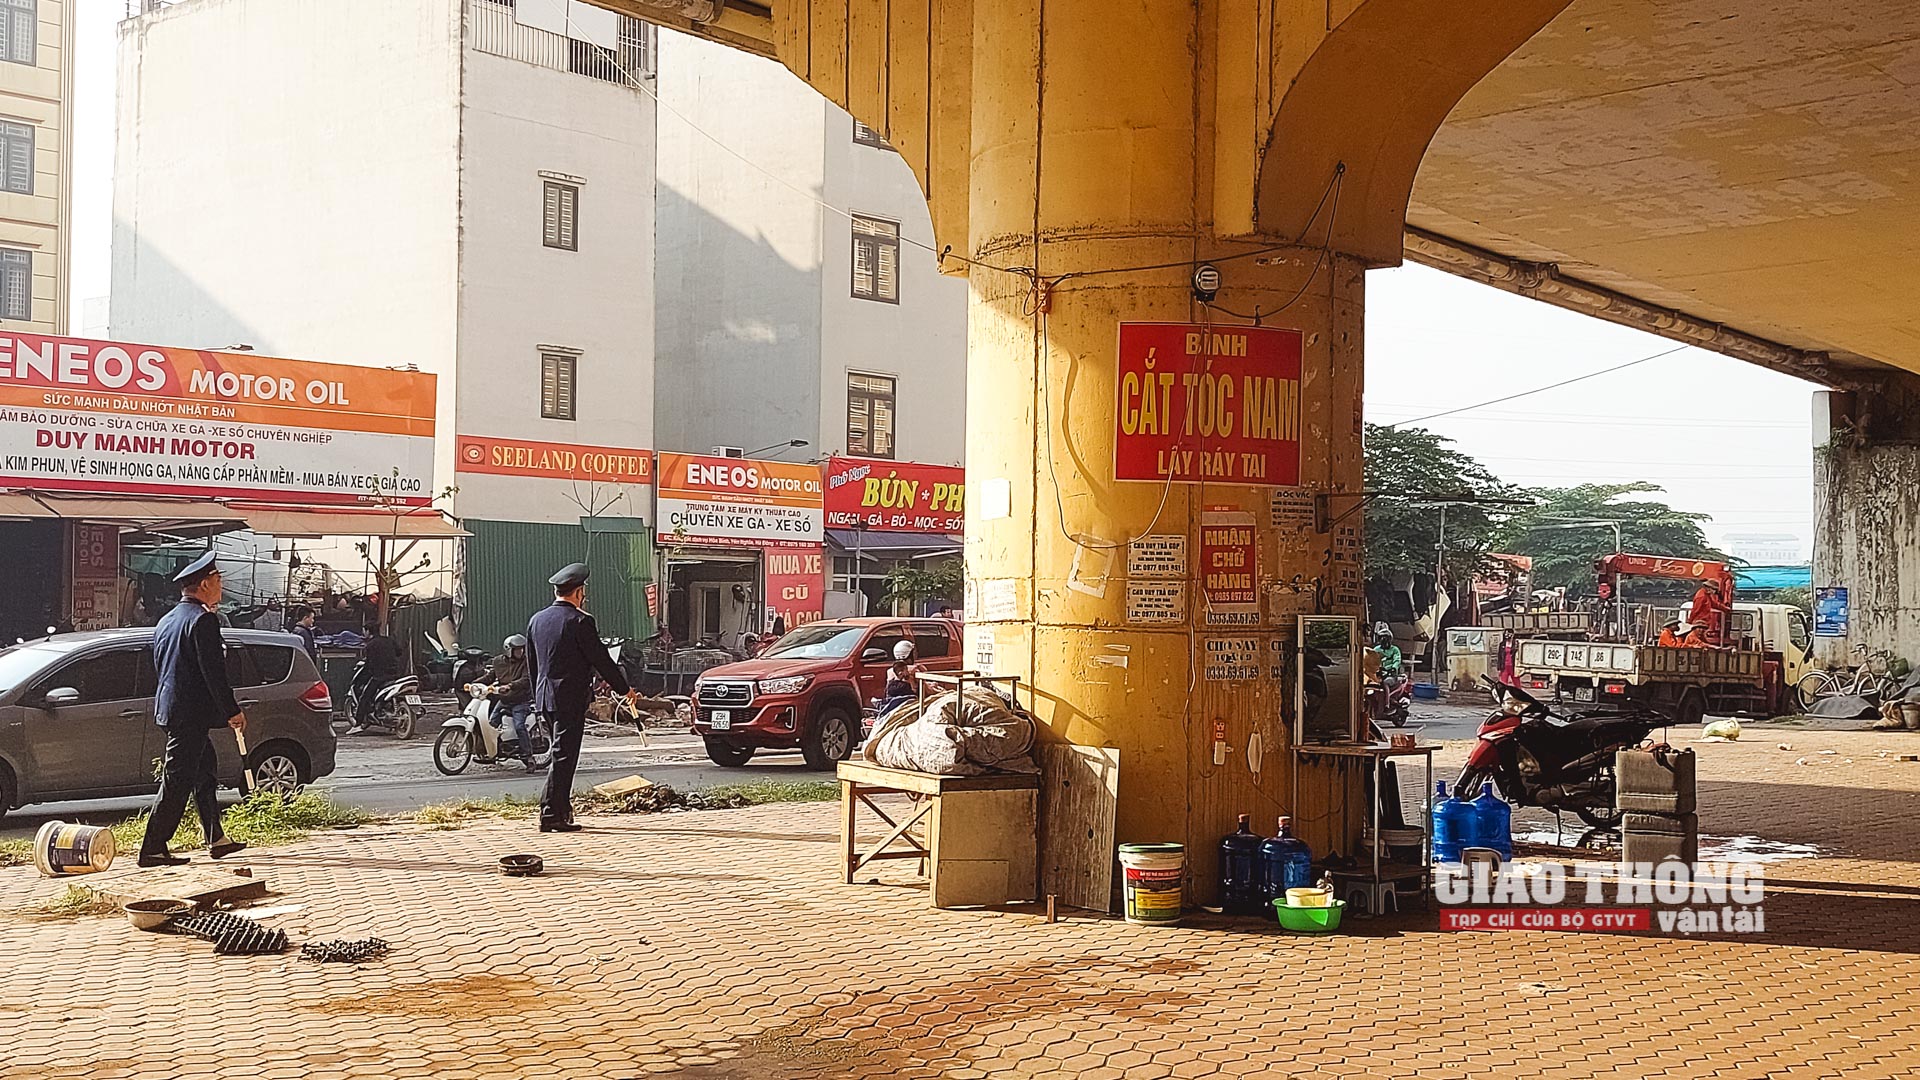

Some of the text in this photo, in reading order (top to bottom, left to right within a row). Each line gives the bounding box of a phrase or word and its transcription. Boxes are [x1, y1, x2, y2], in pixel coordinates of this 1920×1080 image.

[1186, 328, 1247, 357] BÌNH
[189, 369, 296, 402] MOTOR
[305, 380, 349, 405] OIL
[1121, 347, 1299, 441] CẮT TÓC NAM
[43, 391, 235, 418] SỨC MẠNH DẦU NHỚT NHẬT BẢN
[21, 409, 47, 424] BẢO
[50, 412, 97, 428] DƯỠNG
[107, 417, 133, 430] SỬA
[136, 420, 168, 433] CHỮA
[172, 423, 186, 434] XE
[189, 424, 205, 435] GA
[229, 425, 244, 438] SỐ
[247, 428, 291, 442] CHUYÊN
[293, 431, 333, 446] NGHIỆP
[36, 429, 255, 460] DUY MẠNH MOTOR
[5, 455, 28, 471] KIM
[31, 457, 68, 475] PHUN,
[71, 456, 86, 477] VỆ
[90, 460, 117, 476] SINH
[119, 462, 153, 480] HỌNG
[156, 464, 176, 481] GA,
[178, 463, 209, 482] NÂNG
[213, 463, 235, 482] CẤP
[238, 464, 268, 484] PHẦN
[270, 465, 294, 485] MỀM
[302, 472, 325, 486] MUA
[327, 471, 348, 489] BÁN
[350, 475, 364, 489] XE
[400, 478, 421, 492] CAO
[492, 445, 649, 476] SEELAND COFFEE
[1157, 441, 1266, 478] LẤY RÁY TAI
[687, 463, 822, 493] ENEOS MOTOR OIL
[861, 471, 919, 509] BÚN
[670, 511, 811, 533] CHUYÊN XE GA XE SỐ
[686, 503, 709, 512] TRUNG
[727, 505, 737, 514] XE
[787, 509, 801, 518] CAO
[867, 511, 883, 526] GÀ
[890, 512, 907, 527] BÒ
[914, 516, 938, 531] MỌC
[1205, 527, 1251, 550] NHẬN
[769, 554, 821, 575] MUA XE
[1212, 547, 1246, 567] CHỞ
[1628, 557, 1647, 566] UNIC
[1206, 571, 1251, 589] HÀNG
